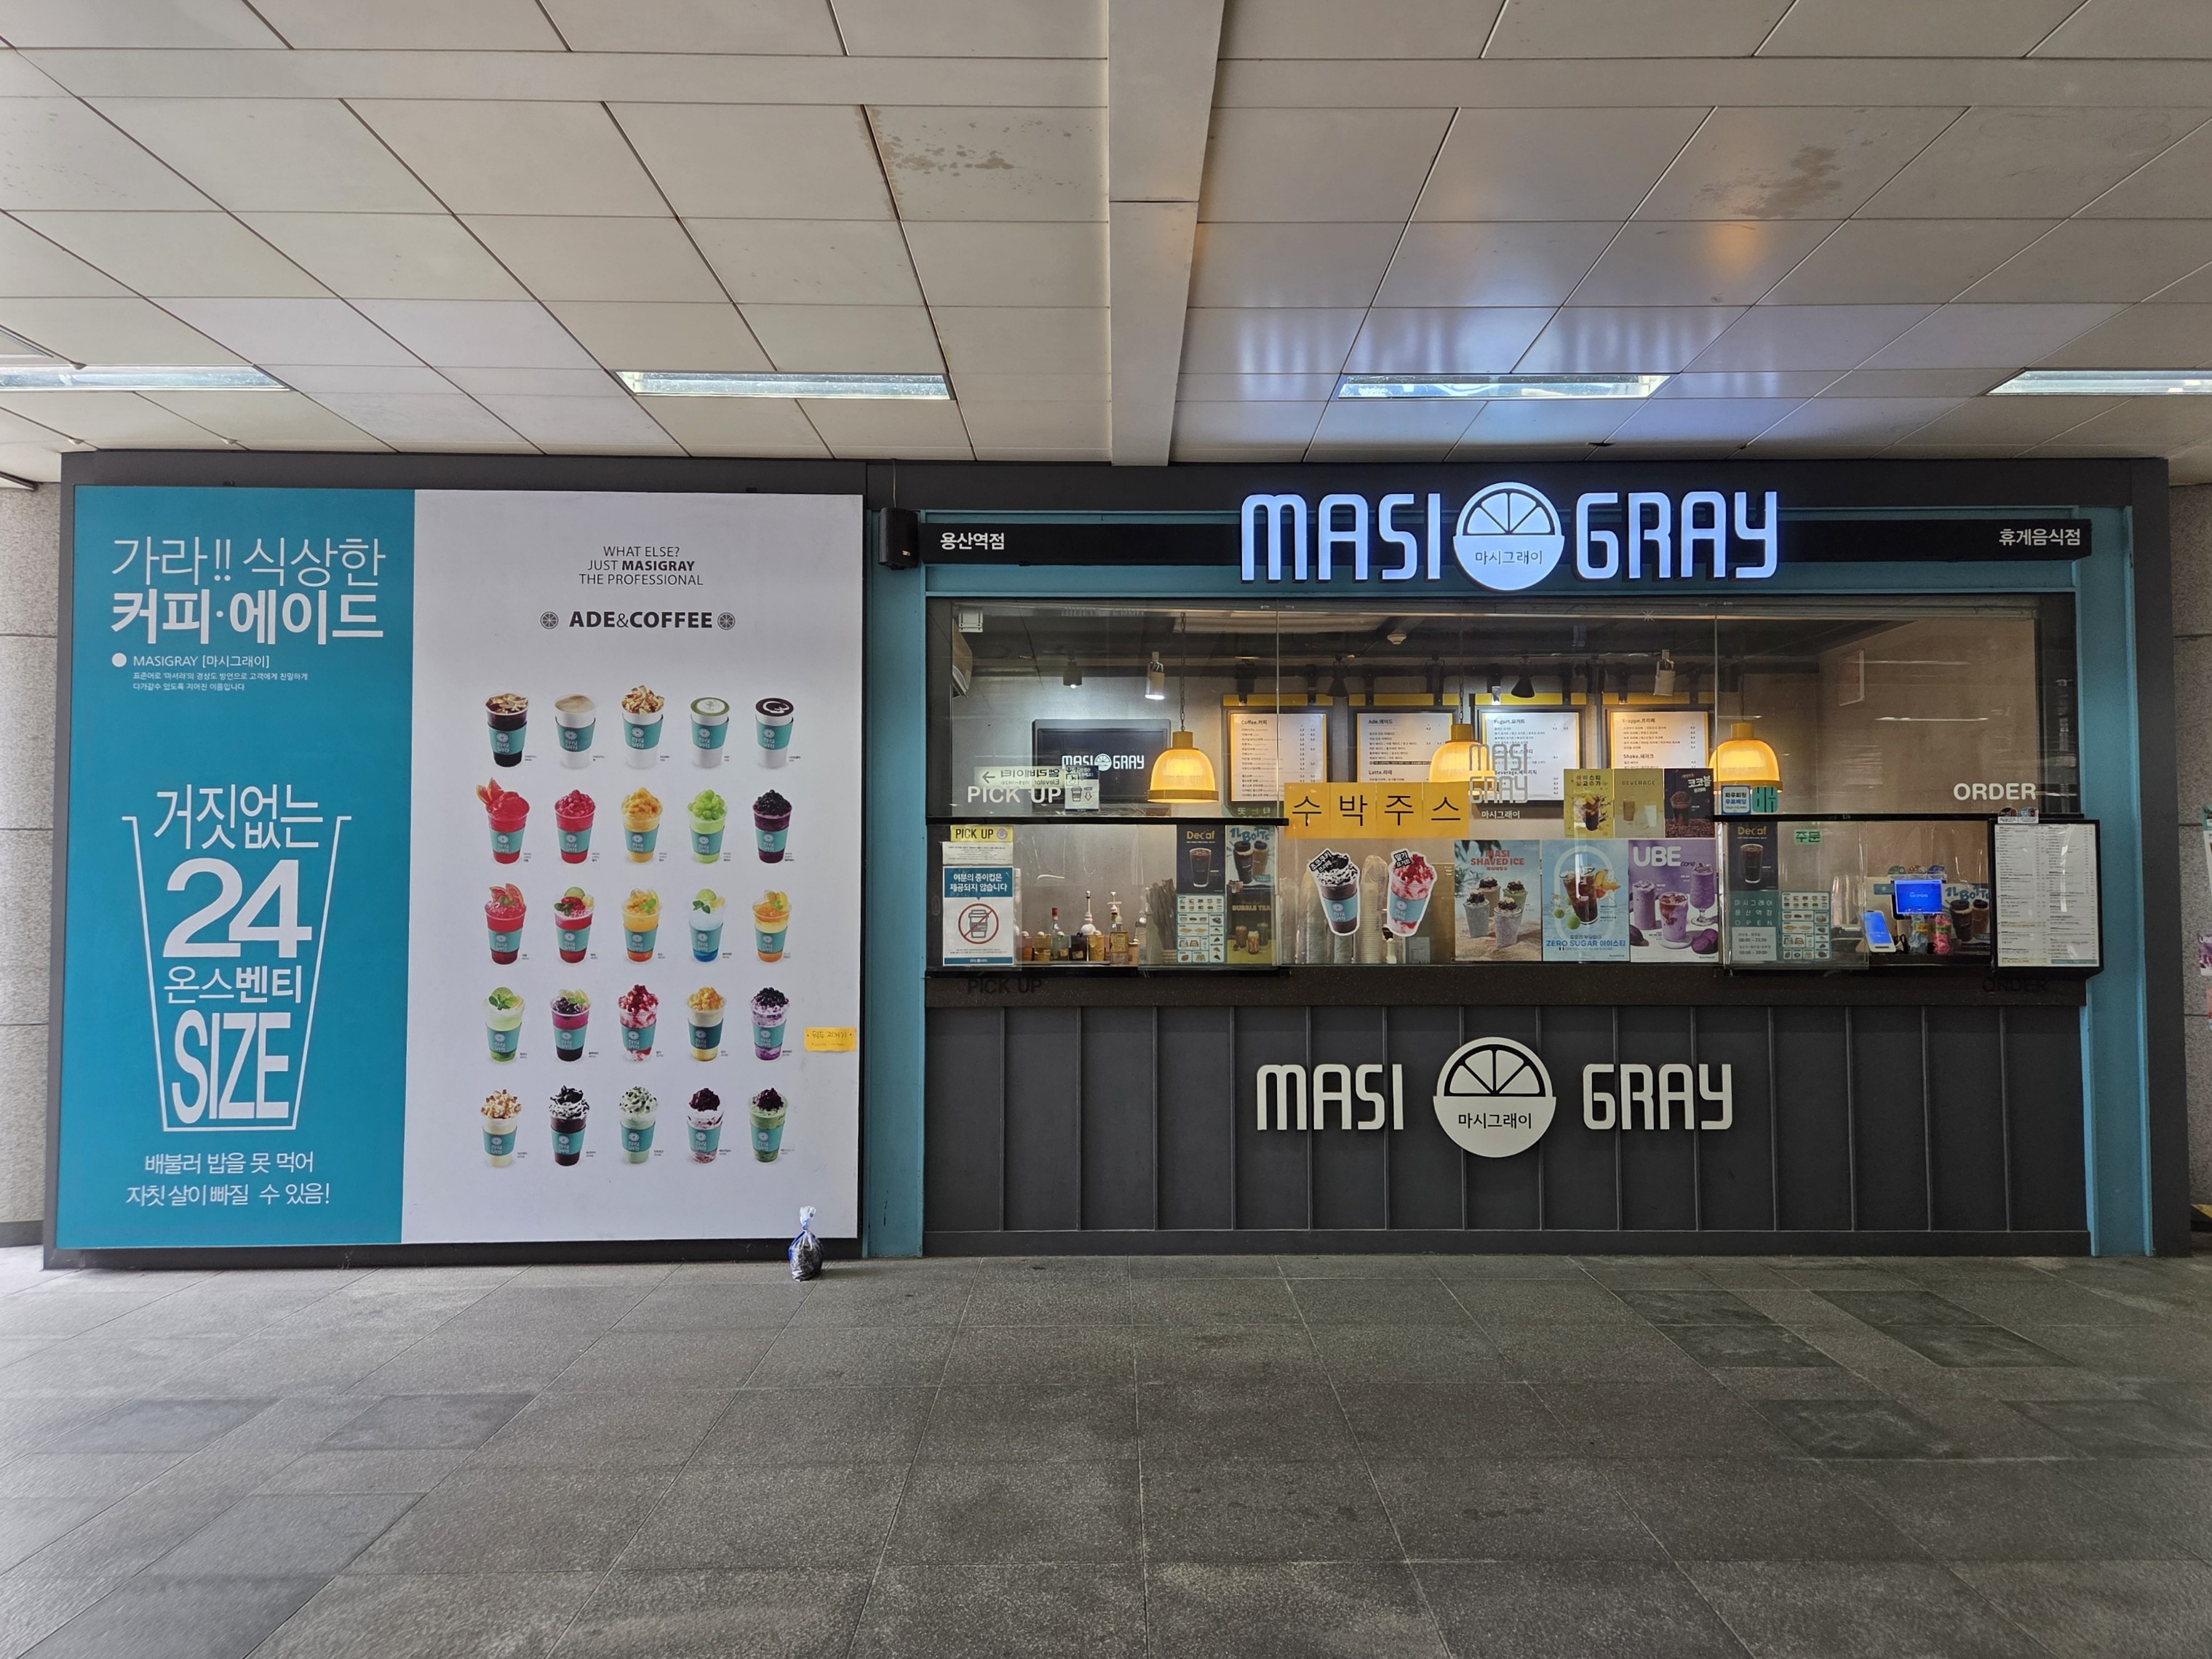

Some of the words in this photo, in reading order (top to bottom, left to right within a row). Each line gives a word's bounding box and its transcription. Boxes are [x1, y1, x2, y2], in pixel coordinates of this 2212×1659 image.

[939, 532, 1006, 551] 용산역점
[1240, 493, 1441, 582] MASI
[1575, 490, 1780, 581] GRAY
[1998, 526, 2081, 548] 휴게음식점
[602, 546, 641, 557] WHAT
[645, 546, 680, 557] ELSE?
[1474, 549, 1544, 567] 마시그래이
[111, 536, 231, 586] 가라!!
[242, 536, 386, 587] 식상한
[587, 560, 618, 570] JUST
[621, 560, 696, 572] MASIGRAY
[578, 573, 605, 585] THE
[608, 573, 704, 586] PROFESSIONAL
[111, 588, 384, 645] 커피·에이드
[568, 610, 713, 629] ADE&COFFEE
[133, 656, 199, 667] MASIGRAY
[202, 655, 270, 669] [마시그래이]
[196, 672, 218, 680] 경상도
[249, 673, 279, 681] 고객에게
[163, 683, 184, 691] 있도록
[186, 683, 208, 691] 지어진
[209, 683, 245, 691] 이름입니다
[1062, 755, 1094, 768] MASI
[1113, 755, 1145, 770] GRAY
[1468, 743, 1528, 771] MASI
[1468, 776, 1528, 804] GRAY
[1687, 775, 1712, 788] 코코볼
[967, 786, 1021, 803] PICK
[1030, 786, 1062, 803] UP
[1953, 782, 2037, 801] ORDER
[153, 784, 324, 850] 거짓없는
[1291, 795, 1462, 827] 수박주스
[1481, 810, 1521, 819] 마시그래이
[955, 828, 977, 839] PICK
[981, 828, 994, 839] UP
[1186, 830, 1215, 840] Decaf
[1738, 826, 1767, 835] Decaf
[1796, 830, 1821, 843] 주문
[1471, 858, 1509, 866] SHAVED
[1510, 858, 1525, 866] ICE
[1485, 850, 1511, 858] MASI
[1633, 846, 1682, 867] UBE
[953, 873, 974, 882] 여분의
[975, 873, 1003, 882] 종이컵은
[950, 883, 978, 892] 제공되지
[979, 883, 1008, 892] 않습니다
[162, 857, 313, 959] 24
[163, 965, 302, 1005] 온스벤티
[171, 1009, 292, 1124] SIZE
[1256, 1063, 1404, 1131] MASI
[1582, 1063, 1733, 1131] GRAY
[1457, 1112, 1533, 1130] 마시그래이
[145, 1152, 202, 1176] 배불러
[207, 1152, 247, 1175] 밥을
[250, 1153, 271, 1174] 못
[276, 1151, 314, 1173] 먹어
[210, 1185, 250, 1206] 빠질
[258, 1185, 281, 1206] 수
[285, 1182, 330, 1206] 있음!
